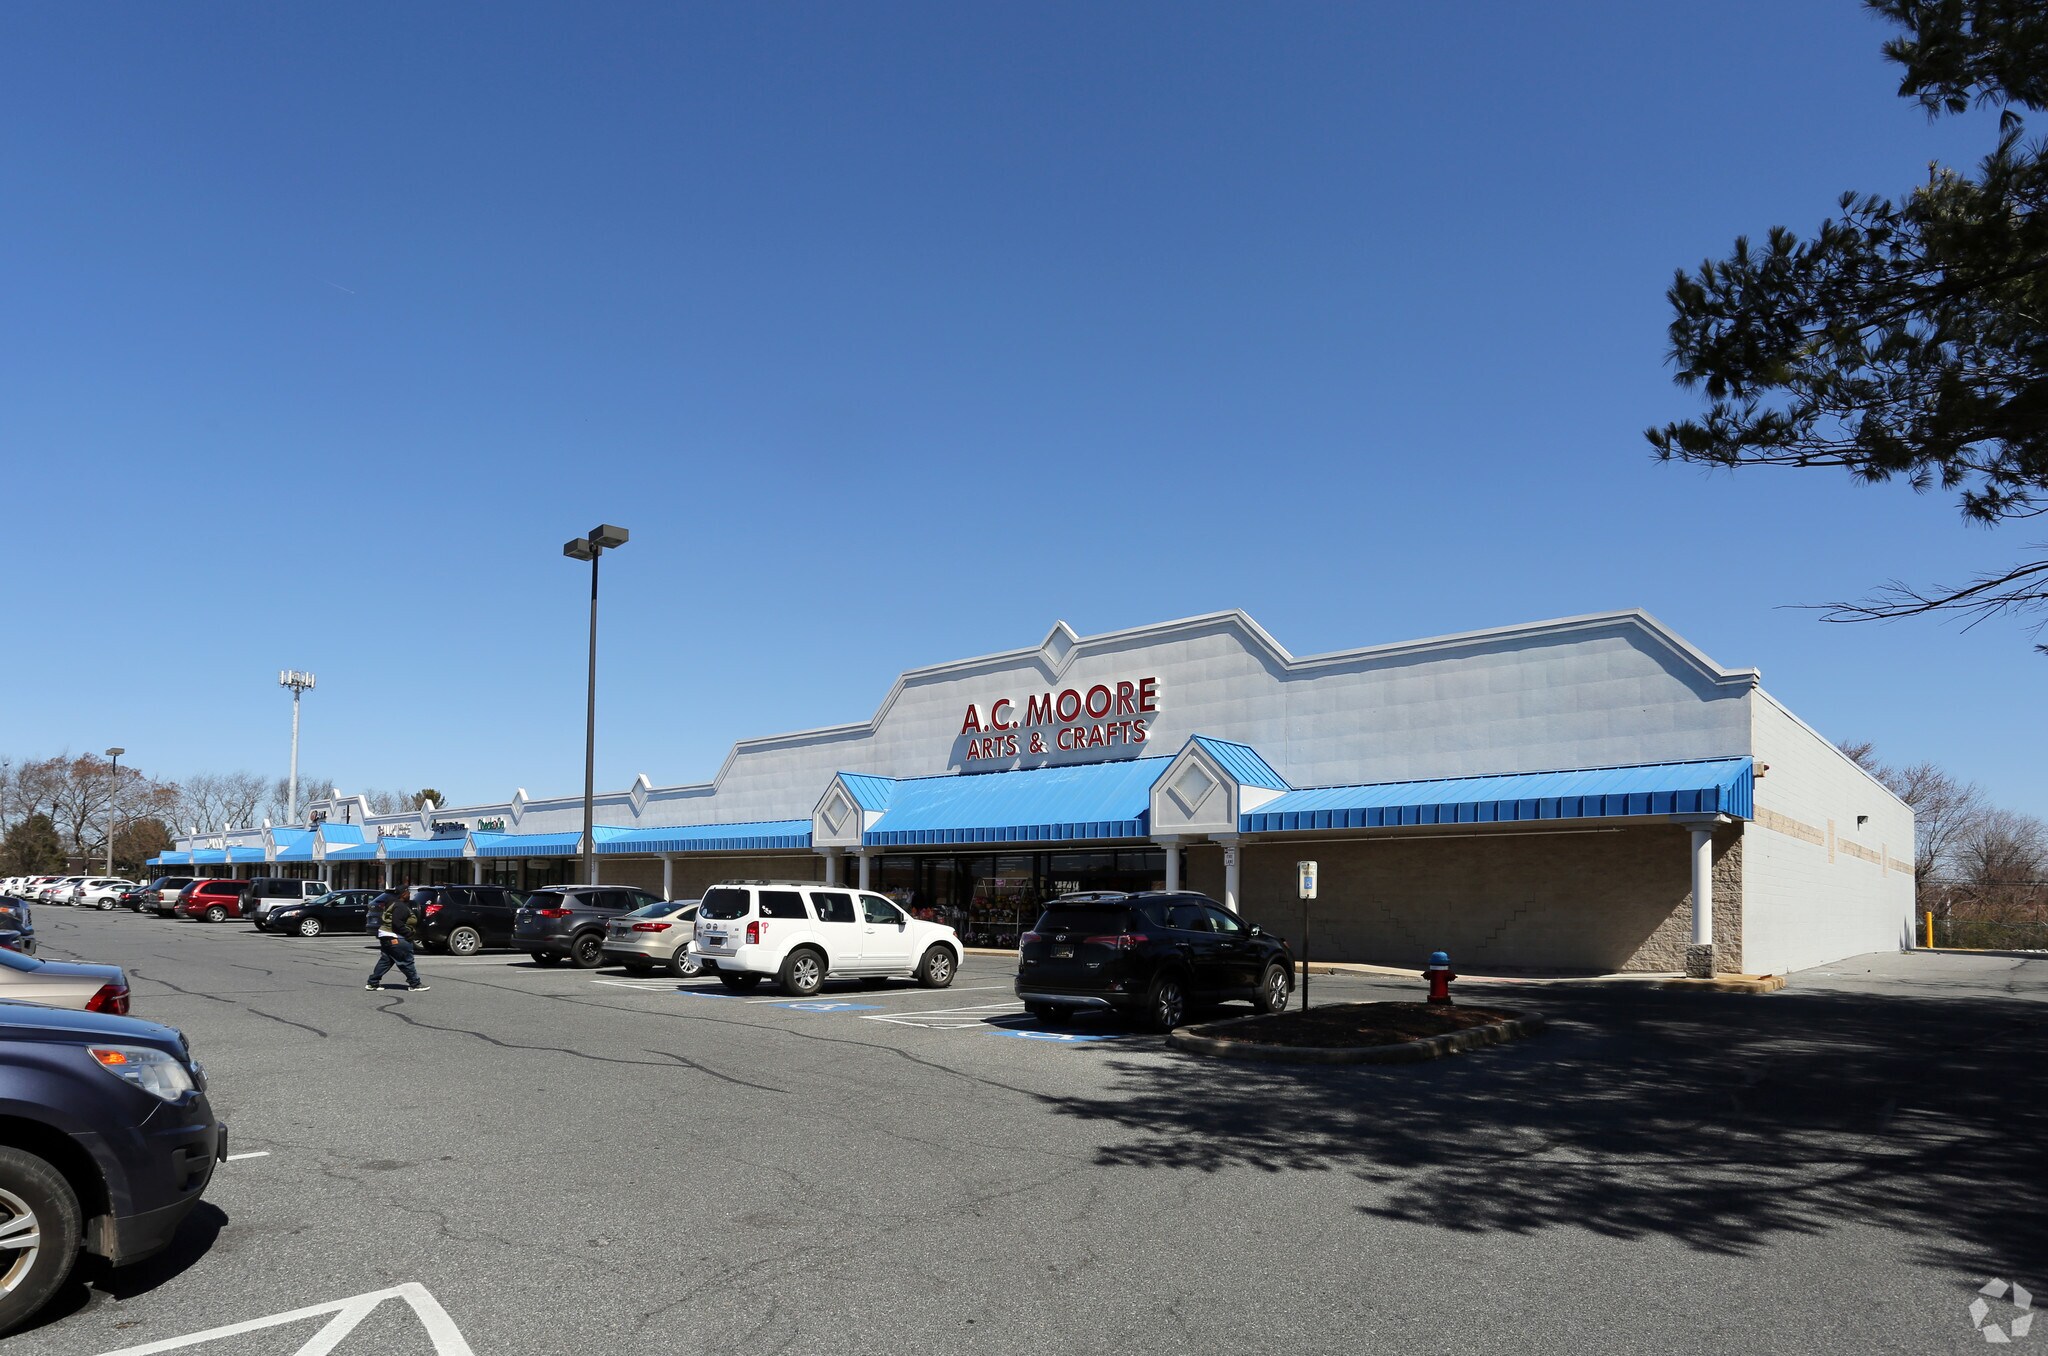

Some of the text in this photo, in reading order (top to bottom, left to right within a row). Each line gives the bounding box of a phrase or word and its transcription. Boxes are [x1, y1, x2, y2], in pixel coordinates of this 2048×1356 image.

[961, 677, 1160, 735] A.C. MOORE
[966, 719, 1150, 760] ARTS & CRAFTS
